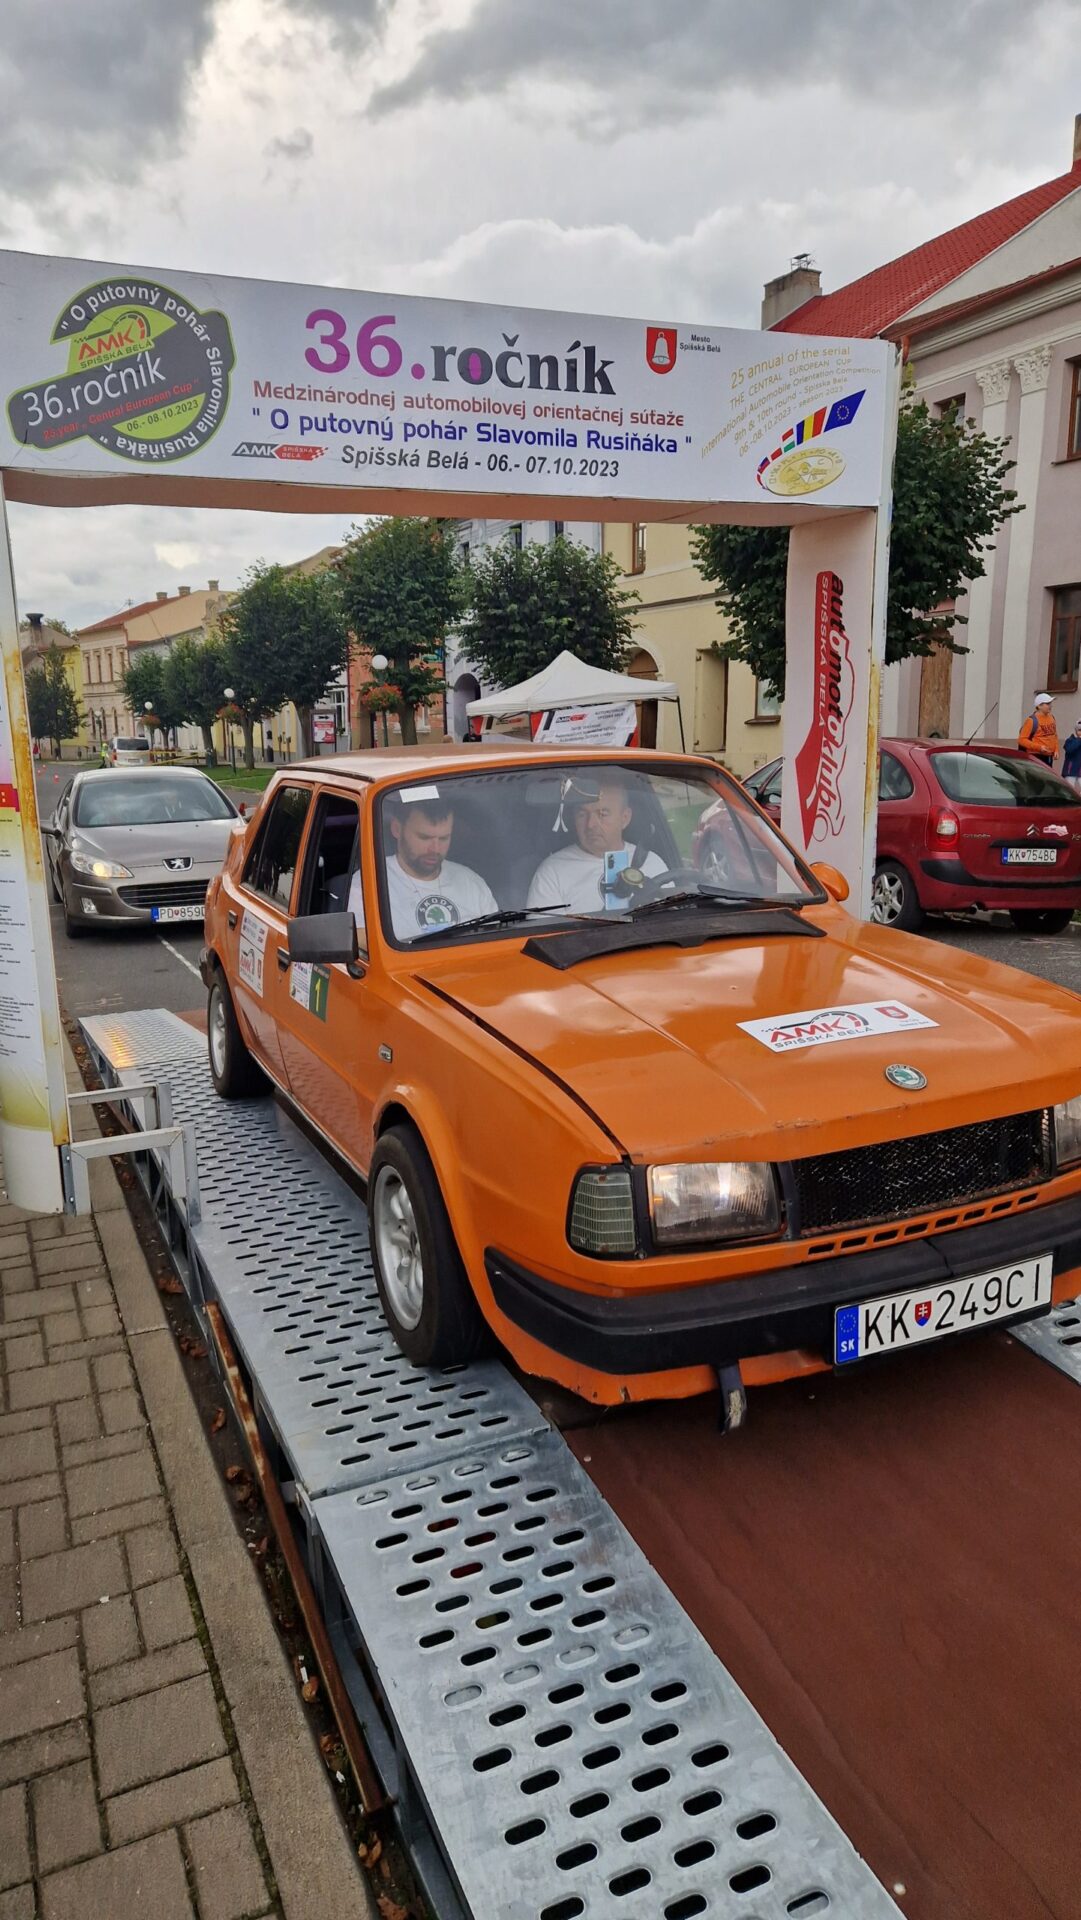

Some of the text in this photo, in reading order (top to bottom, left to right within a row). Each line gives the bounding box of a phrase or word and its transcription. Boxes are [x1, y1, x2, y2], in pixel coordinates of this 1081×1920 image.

[86, 285, 161, 313] putovný
[163, 298, 212, 342] pohár
[78, 323, 136, 361] AMK
[305, 308, 617, 396] 36.ročník
[691, 333, 711, 343] Mesto
[22, 350, 167, 427] 36.ročník
[729, 391, 745, 410] THE
[748, 373, 782, 397] CENTRAL
[789, 360, 830, 376] EUROPEAN
[730, 346, 850, 389] 25 annual of the serial
[88, 405, 123, 425] Central
[125, 389, 171, 413] European
[172, 382, 193, 396] Cup
[196, 346, 224, 433] Slavomila
[253, 380, 685, 427] Medzinárodnej automobilovej orientačnej súťaže
[147, 399, 199, 425] 08.10.2023
[270, 408, 290, 430] O
[299, 413, 394, 442] putovný
[403, 419, 468, 443] pohár
[476, 422, 578, 448] Slavomila
[586, 430, 678, 454] Rusiňáka
[701, 407, 748, 459] International
[748, 382, 792, 415] Automobile
[792, 369, 835, 387] Orientation
[734, 428, 747, 445] 9th
[757, 406, 774, 422] 10th
[775, 391, 797, 409] round
[115, 431, 200, 459] Rusiňáka
[341, 444, 420, 469] Spišská
[426, 449, 469, 470] Belá
[525, 455, 620, 478] 07.10.2023
[815, 573, 845, 810] automotoklub
[1008, 849, 1056, 861] KK 754BC
[160, 908, 174, 919] PD
[770, 1016, 846, 1043] AMK
[864, 1263, 1041, 1350] KK 249CI
[840, 1337, 855, 1353] SK
